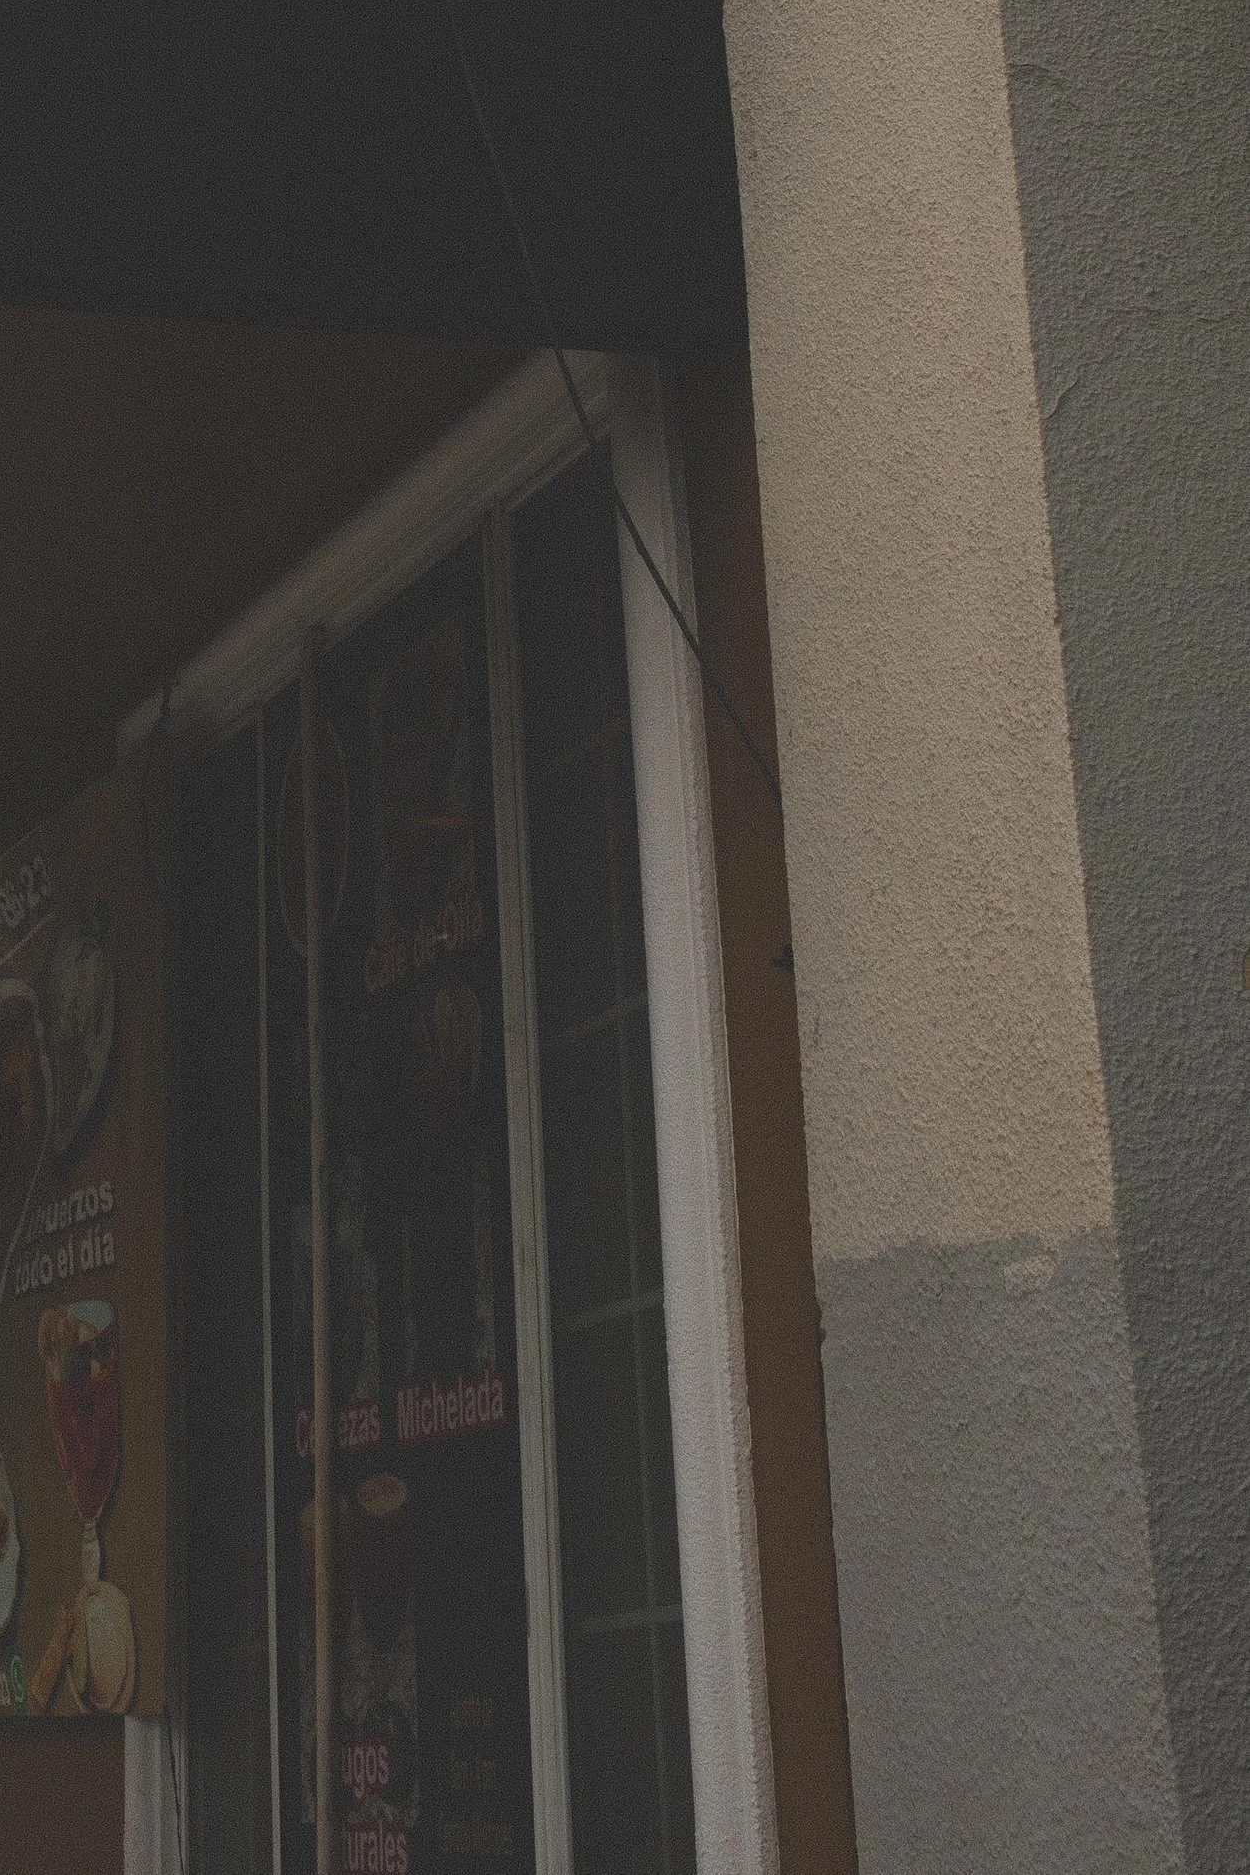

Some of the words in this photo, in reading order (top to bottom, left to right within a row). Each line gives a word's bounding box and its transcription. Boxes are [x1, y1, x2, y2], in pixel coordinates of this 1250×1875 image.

[57, 1235, 74, 1278] el
[80, 1224, 116, 1271] día
[397, 1369, 504, 1441] Michelada
[344, 1745, 389, 1798] ugos
